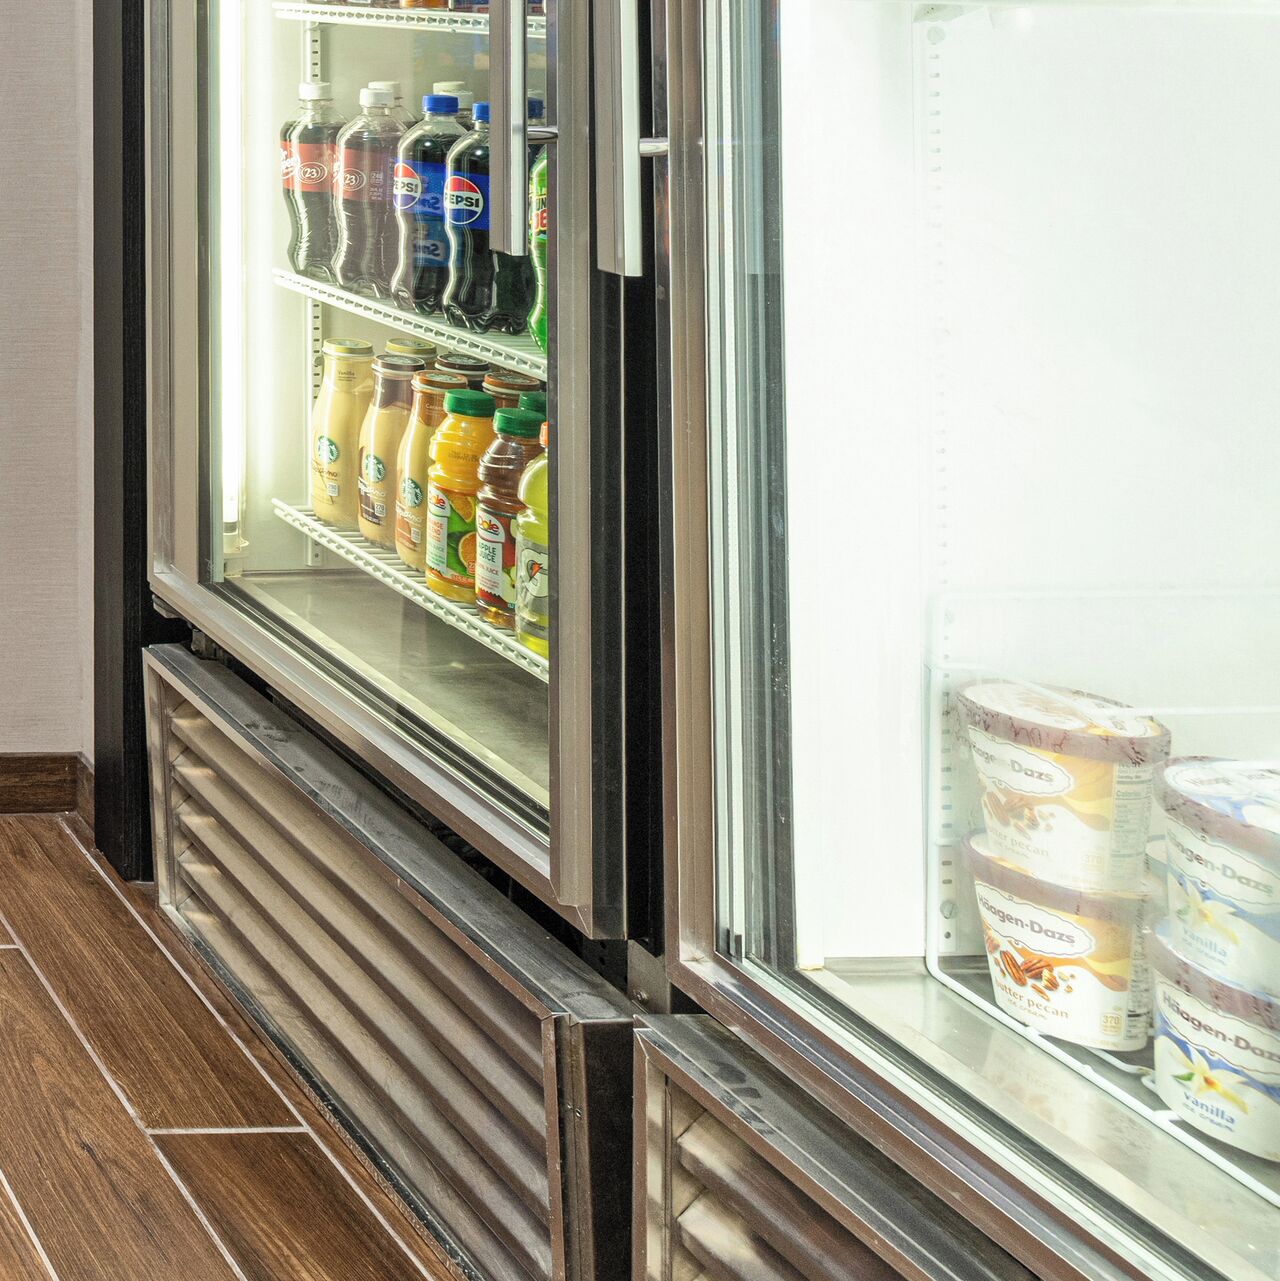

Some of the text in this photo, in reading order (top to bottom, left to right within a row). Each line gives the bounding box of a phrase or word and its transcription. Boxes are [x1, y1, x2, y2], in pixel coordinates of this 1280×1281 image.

[978, 895, 1076, 946] Häagen-Dazs
[1183, 927, 1228, 958] vanilla
[1027, 993, 1070, 1019] pecan
[1102, 1014, 1120, 1026] 370
